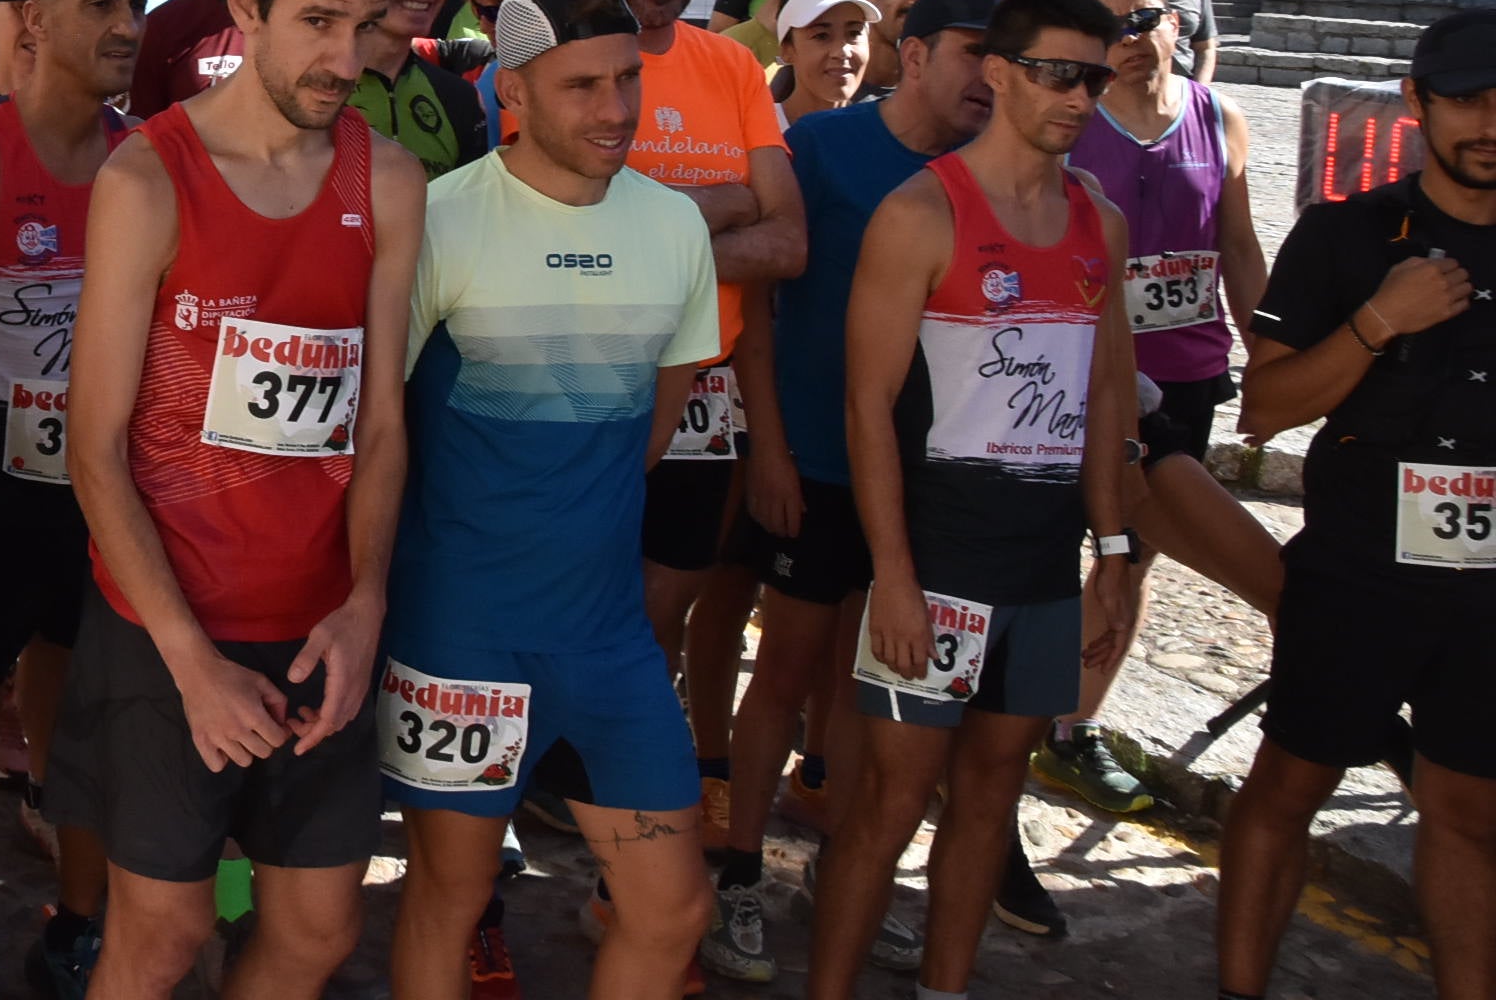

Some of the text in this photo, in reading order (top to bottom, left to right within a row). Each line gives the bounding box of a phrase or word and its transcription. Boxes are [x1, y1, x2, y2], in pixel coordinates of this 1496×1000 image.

[202, 295, 257, 307] LA BAÑEZA
[1144, 277, 1198, 311] 353
[222, 326, 360, 369] bedunia
[247, 371, 342, 424] 377
[986, 442, 1033, 455] Ibéricos
[1403, 468, 1496, 498] bedu
[1431, 501, 1493, 541] 35
[382, 663, 525, 718] bedunia
[396, 710, 491, 764] 320
